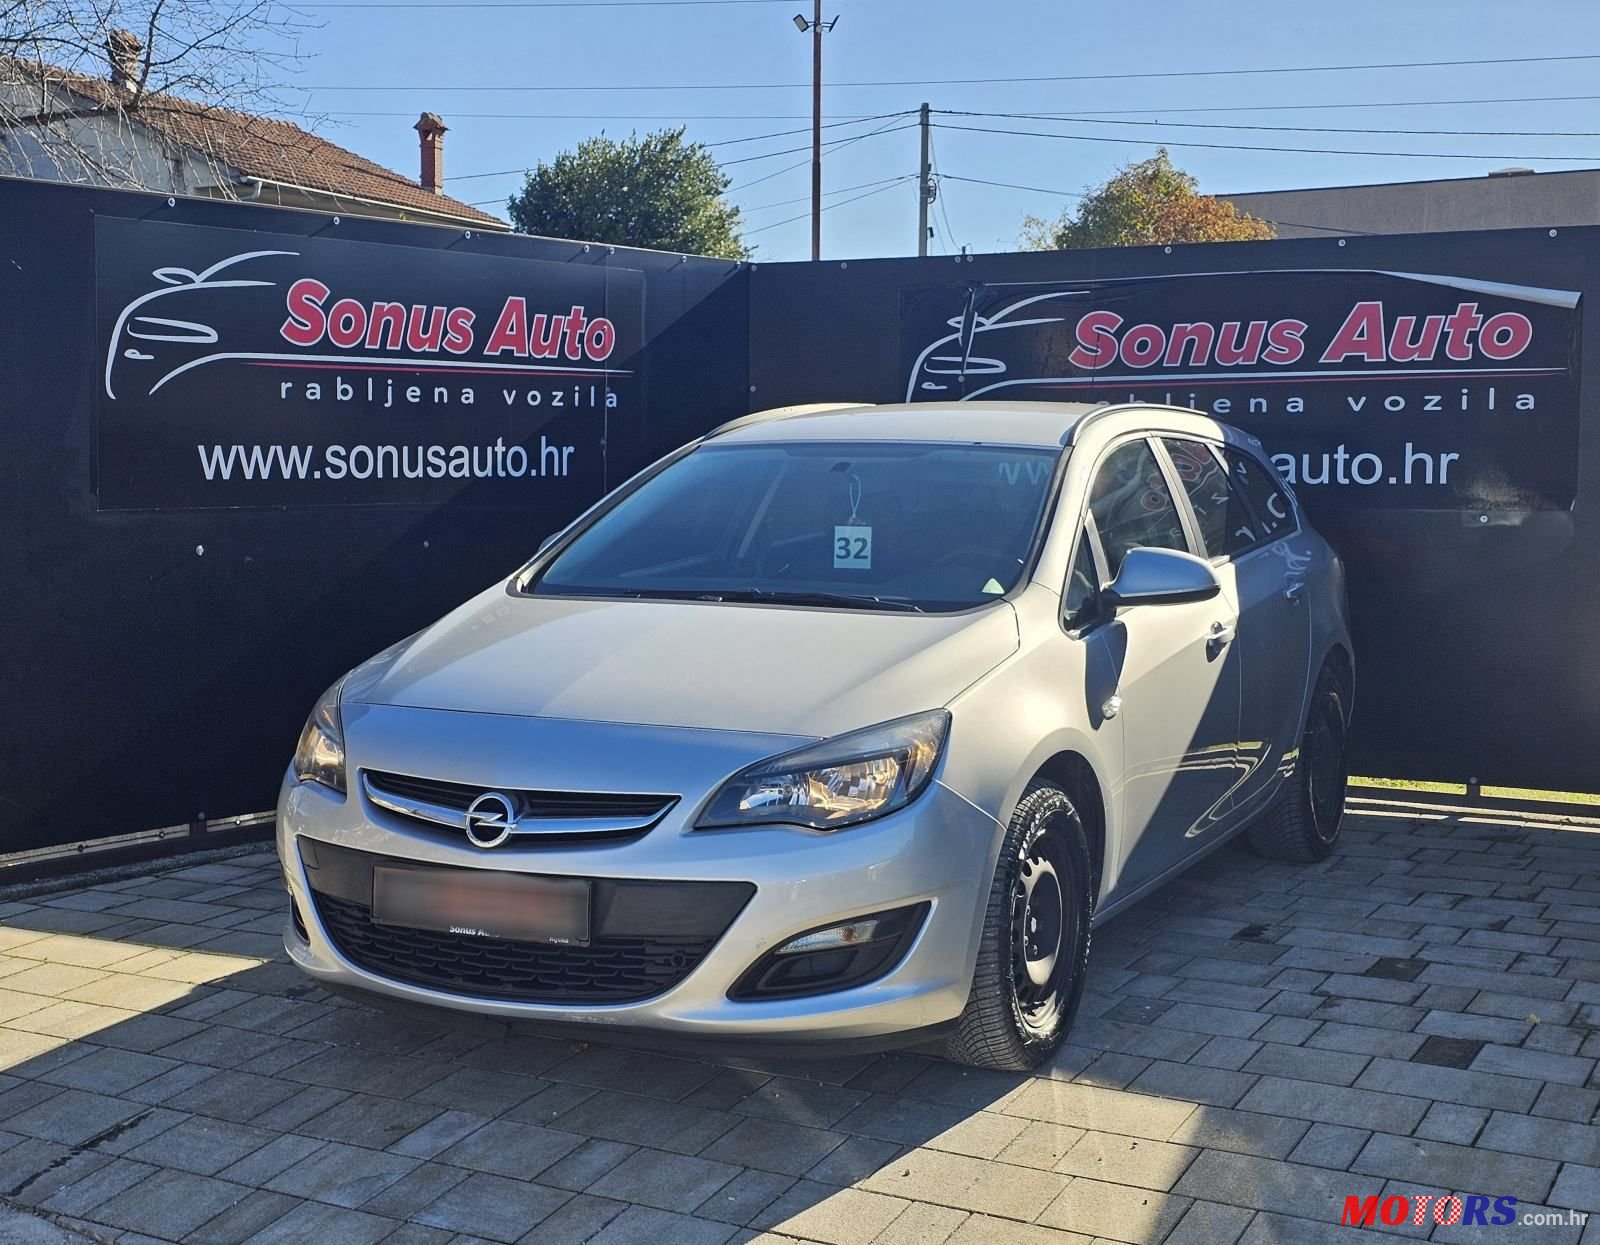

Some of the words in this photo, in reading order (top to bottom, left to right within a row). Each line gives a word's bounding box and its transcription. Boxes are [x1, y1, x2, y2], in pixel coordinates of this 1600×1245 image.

[280, 278, 474, 353] Sonus
[484, 295, 616, 361] Auto
[1069, 311, 1305, 368] Sonus
[1320, 301, 1533, 363] Auto
[280, 377, 474, 407] rabljena
[503, 386, 618, 409] vozila
[1348, 388, 1536, 411] vozila
[198, 435, 575, 480] www.sonusauto.hr
[1269, 442, 1460, 485] auto.hr
[835, 537, 869, 560] 32
